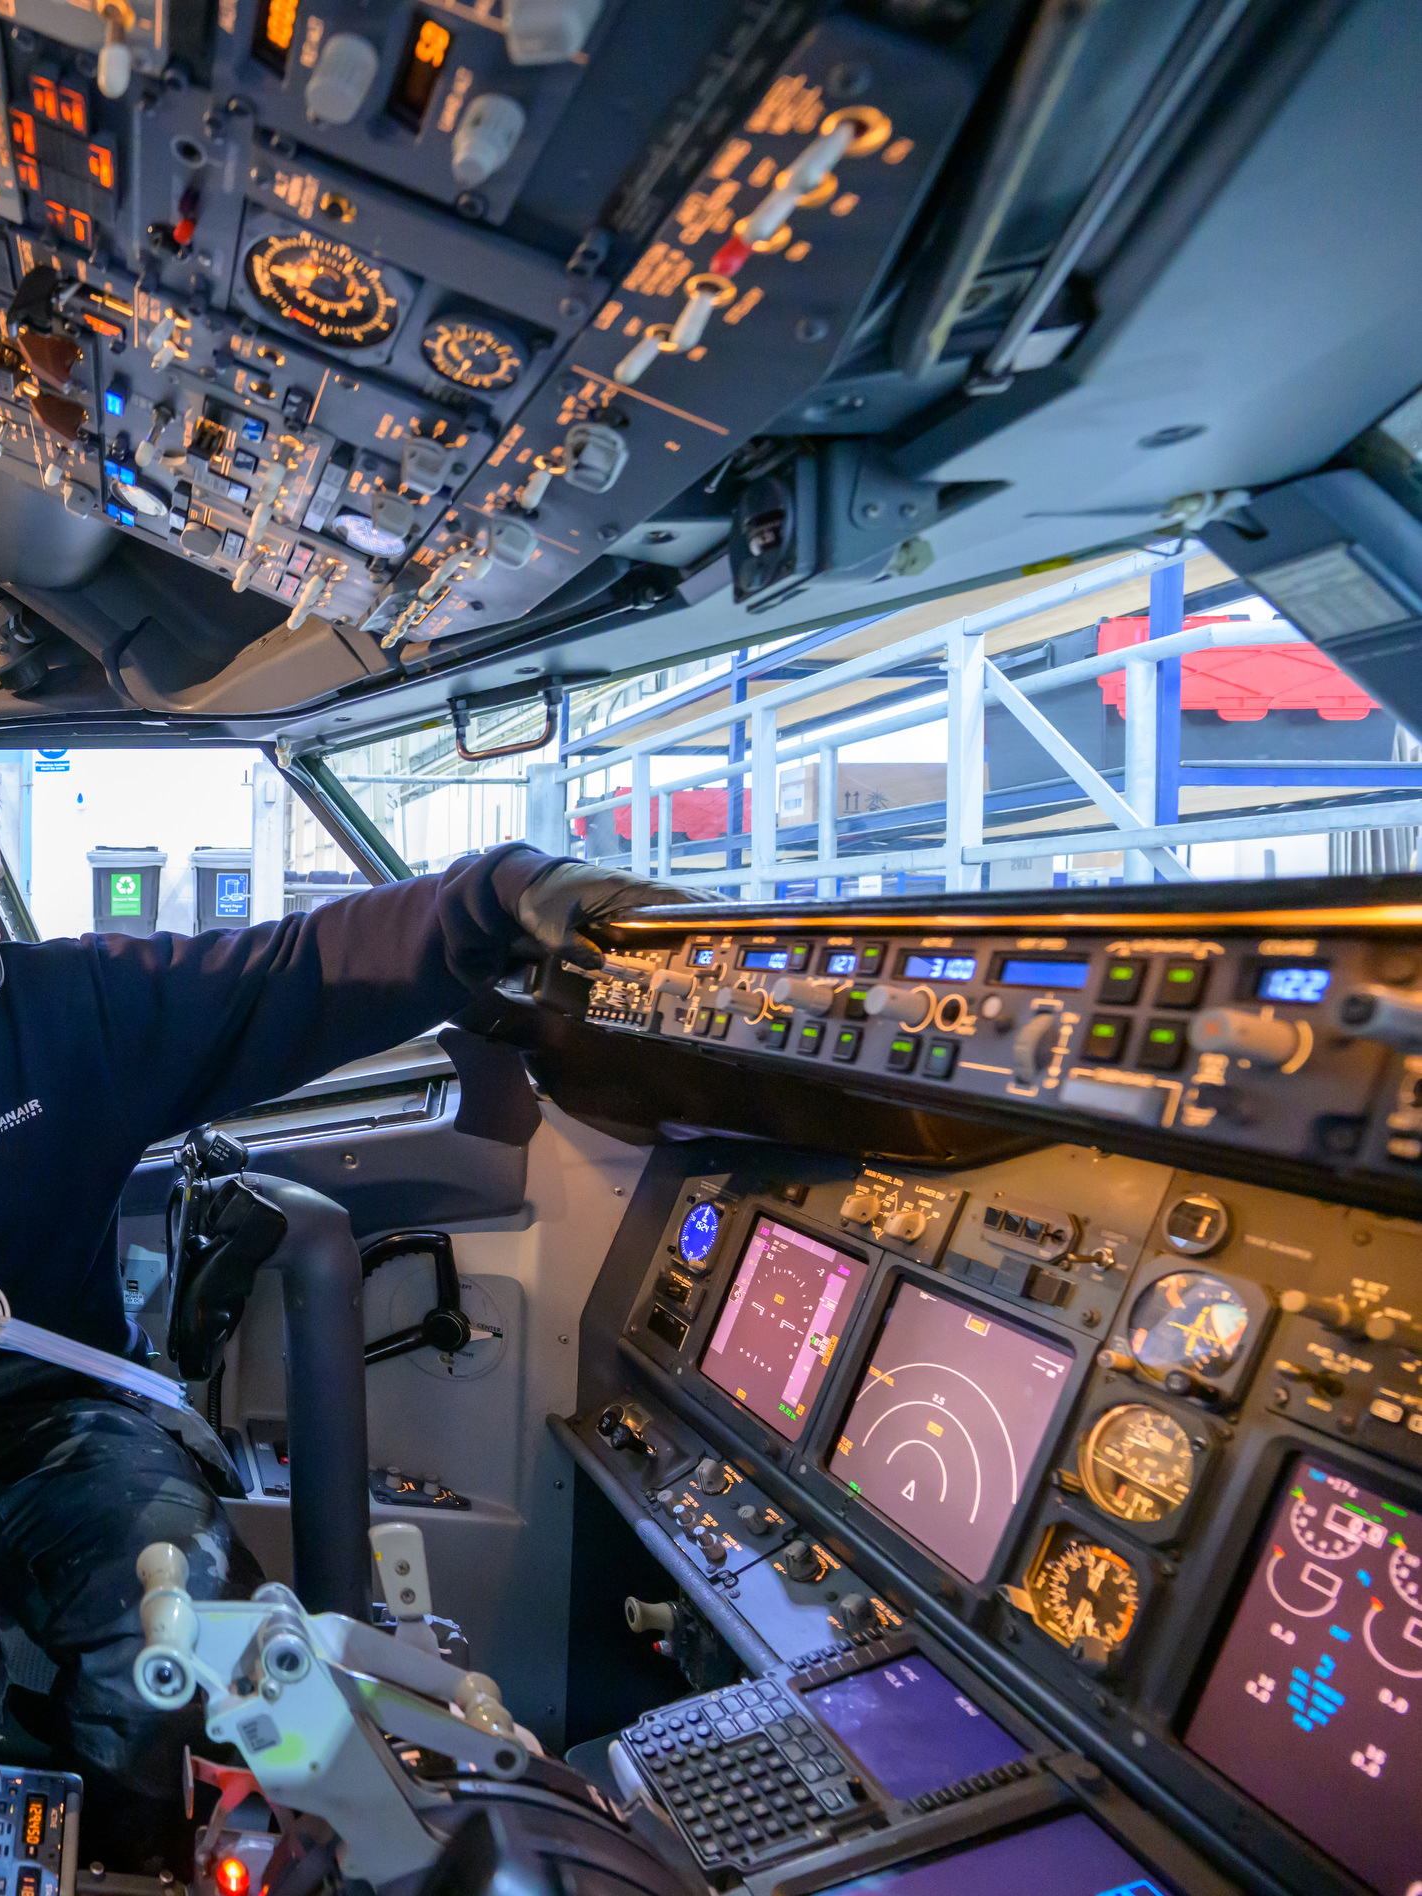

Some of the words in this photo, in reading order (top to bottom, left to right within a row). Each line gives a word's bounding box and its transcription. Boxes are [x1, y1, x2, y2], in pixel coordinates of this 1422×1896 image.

[864, 1168, 878, 1178] MAIN
[877, 1172, 893, 1184] PANEL
[915, 1185, 937, 1198] LOWER
[476, 1322, 501, 1332] CENTER
[932, 1393, 946, 1406] 2.5
[812, 1544, 841, 1570] BACKGROUND
[883, 1608, 903, 1626] FLOOD
